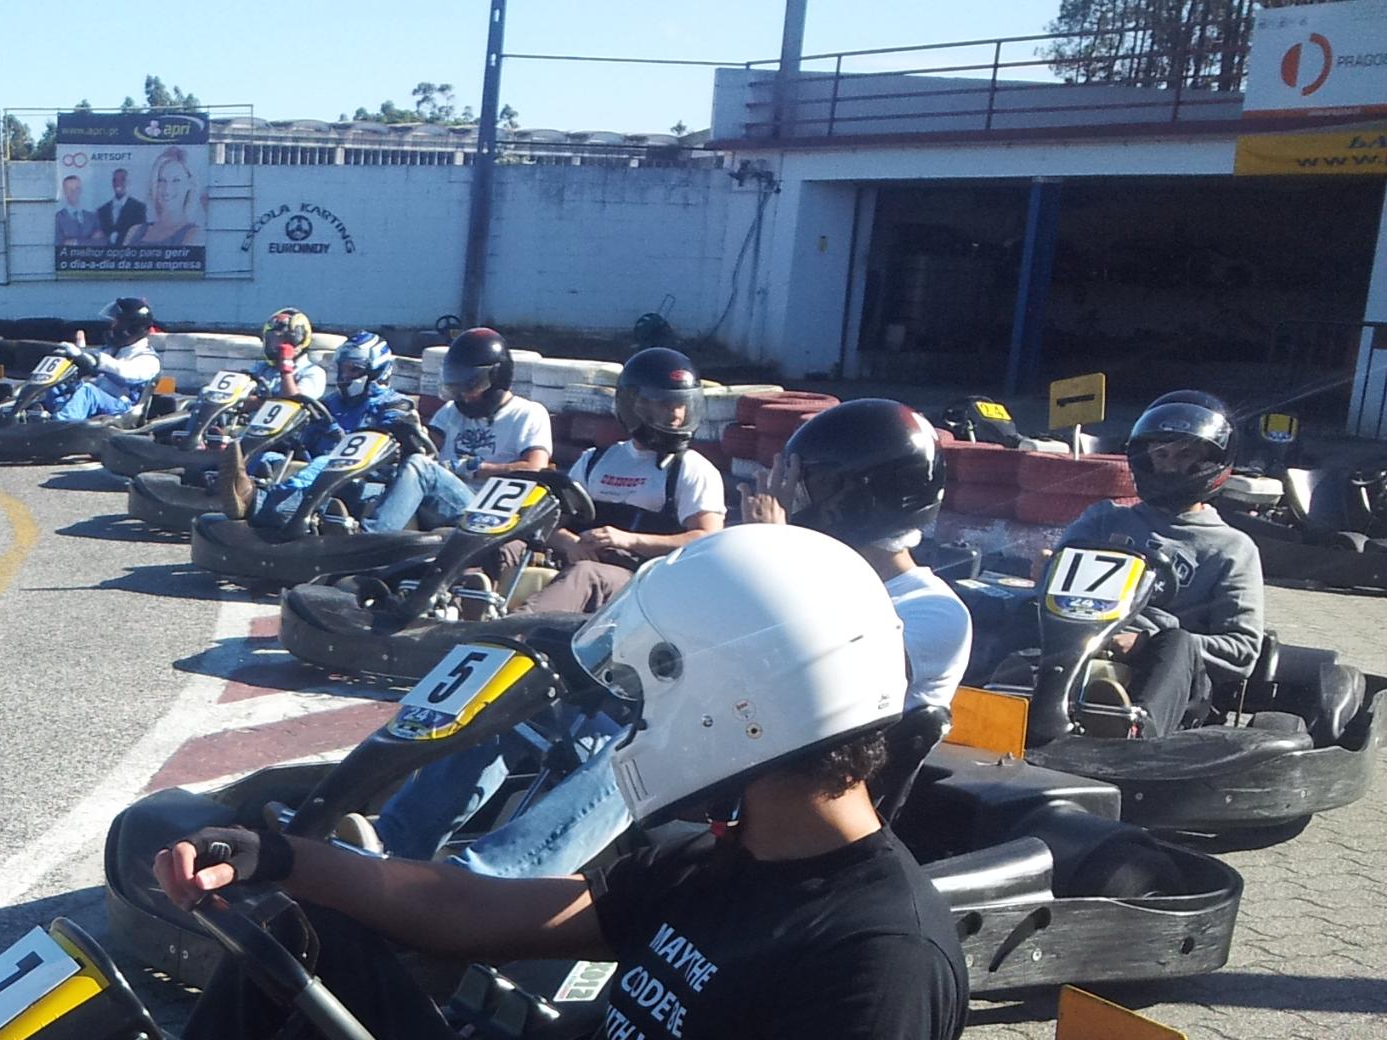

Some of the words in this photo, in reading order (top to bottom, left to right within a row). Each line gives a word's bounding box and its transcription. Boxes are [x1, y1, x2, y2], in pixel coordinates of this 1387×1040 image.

[163, 122, 191, 138] apri
[91, 152, 132, 161] ARTSOFT
[241, 204, 291, 252] ESCOLA
[300, 202, 356, 254] KARTING
[60, 248, 68, 257] A
[71, 247, 104, 257] melhor
[139, 249, 162, 259] para
[164, 248, 191, 259] gerir
[269, 242, 331, 254] EUROINDY
[60, 261, 67, 269] o
[70, 260, 115, 269] dia-a-dia
[118, 260, 130, 269] da
[133, 261, 153, 269] sua
[156, 261, 202, 270] empresa
[38, 357, 60, 373] 16
[218, 374, 235, 390] 6
[263, 404, 283, 424] 9
[340, 435, 367, 457] 8
[477, 479, 528, 512] 12
[1061, 552, 1128, 592] 17
[427, 652, 489, 704] 5
[649, 922, 698, 970] MAY
[685, 951, 719, 993] THE
[620, 966, 681, 1022] CODE
[666, 1000, 688, 1039] BE
